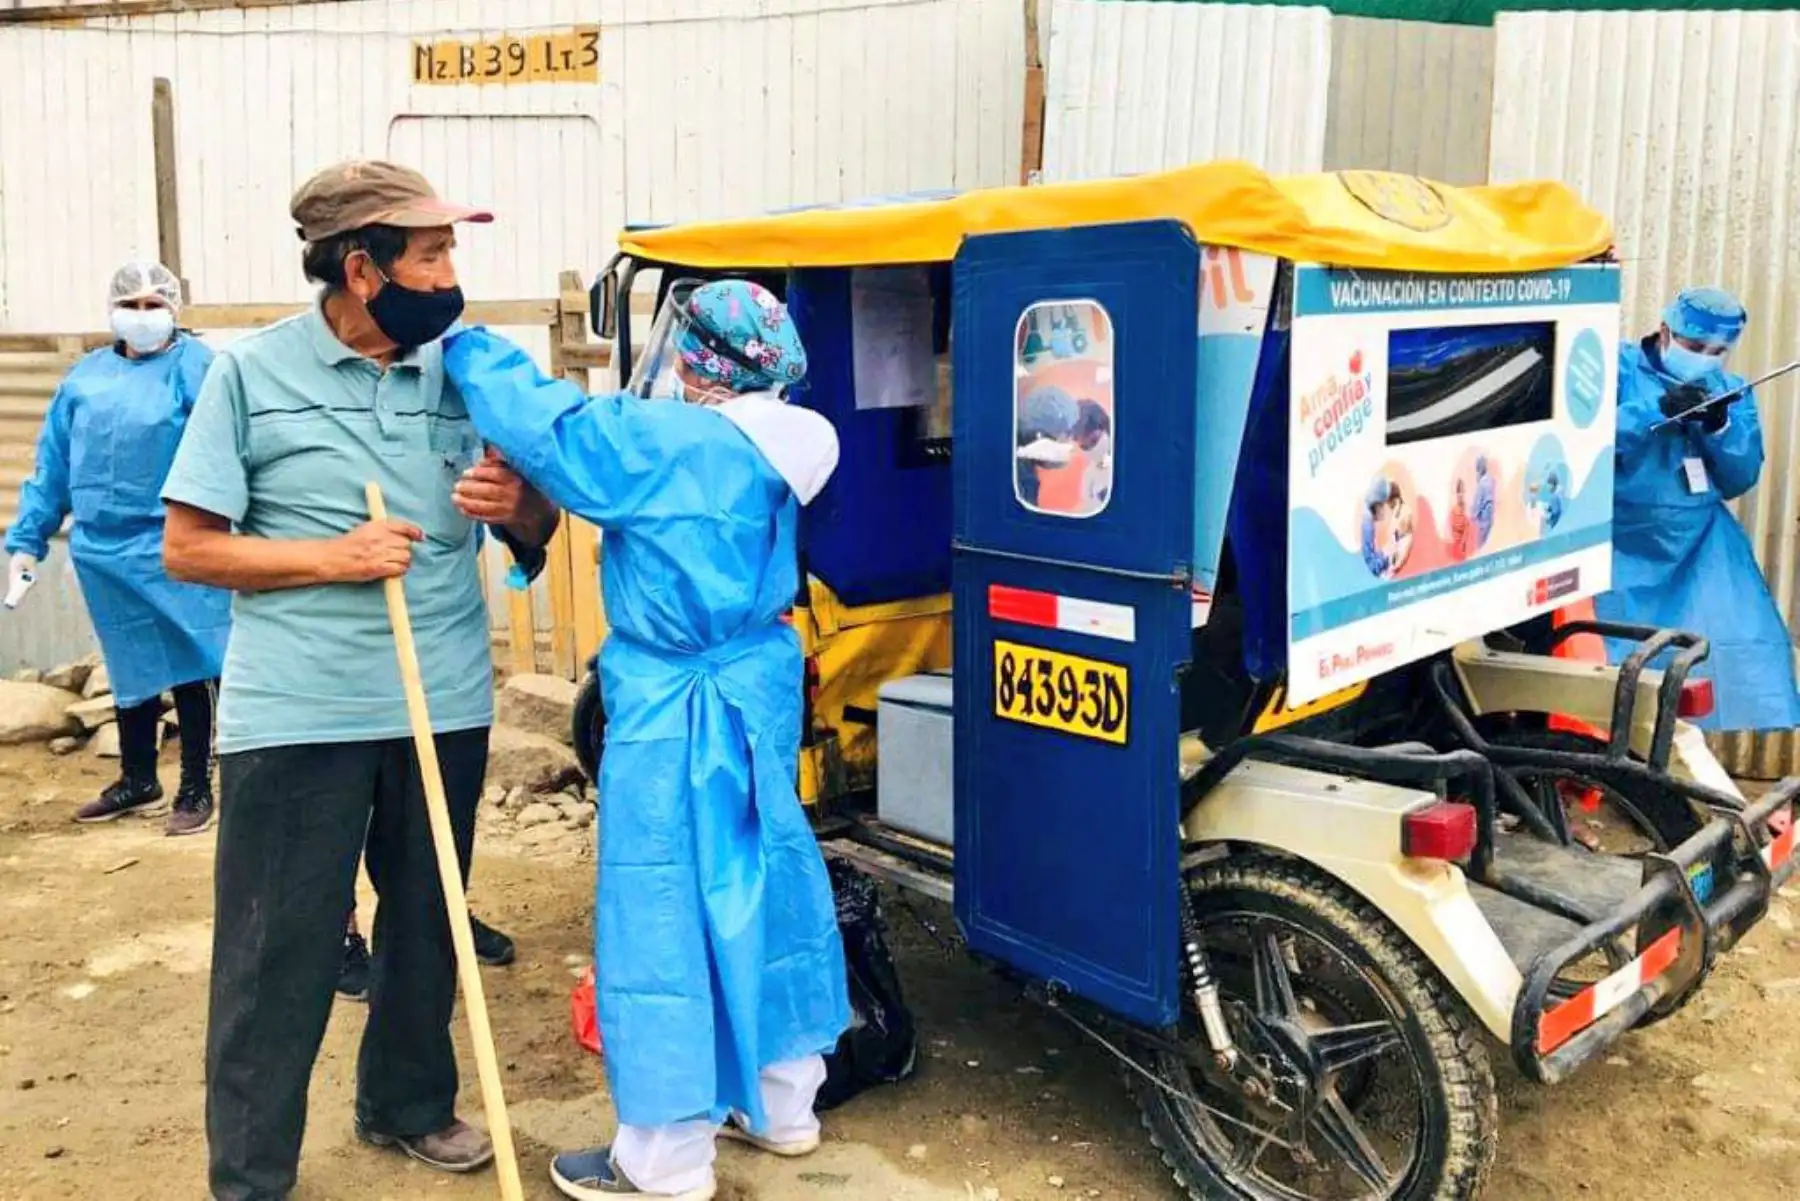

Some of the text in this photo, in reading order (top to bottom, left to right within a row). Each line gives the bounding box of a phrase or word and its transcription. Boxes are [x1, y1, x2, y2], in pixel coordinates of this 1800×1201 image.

[1331, 276, 1571, 308] VACUNACIÓN EN CONTEXTO COVID-19
[1308, 398, 1373, 477] protege
